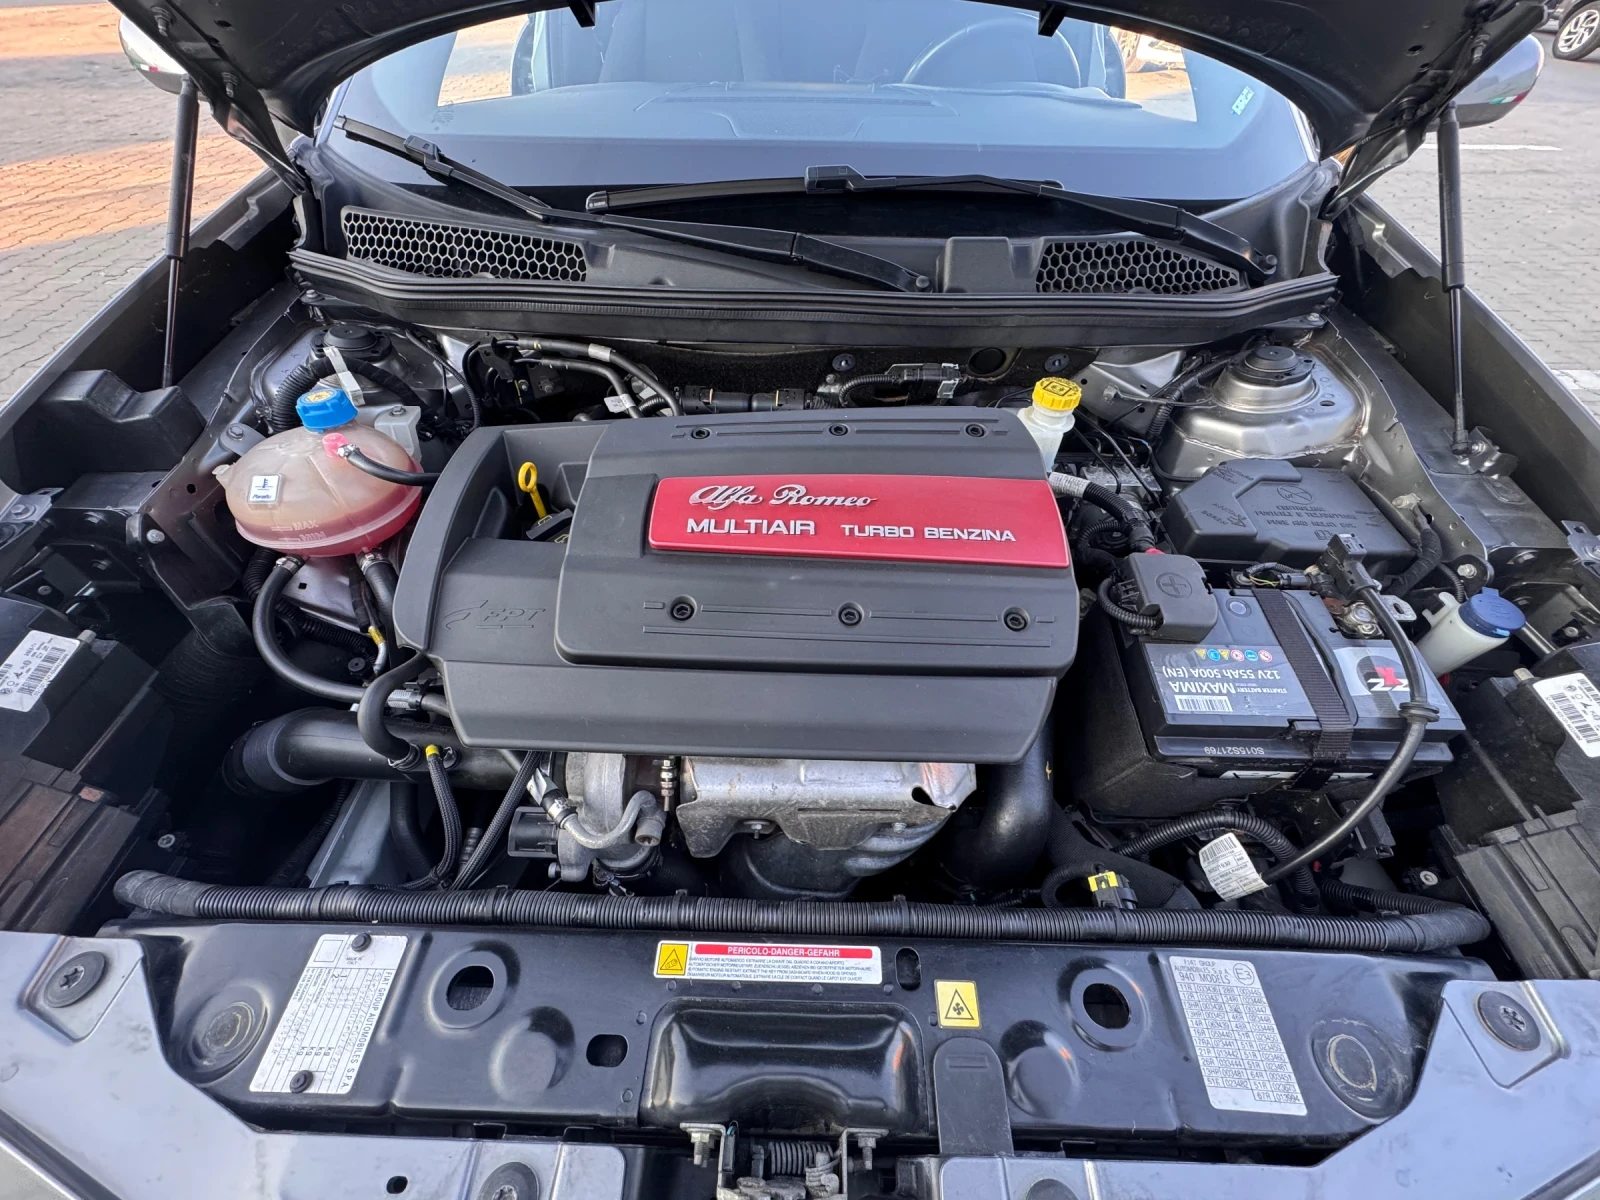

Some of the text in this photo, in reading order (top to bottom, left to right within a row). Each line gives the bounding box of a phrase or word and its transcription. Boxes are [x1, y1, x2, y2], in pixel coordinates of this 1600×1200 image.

[688, 484, 877, 512] Alfa Romeo
[292, 520, 318, 531] MAX
[686, 518, 1017, 543] MULTIAIR TURBO BENZINA
[1162, 666, 1281, 679] 12V 55Ah 500A (EN)
[1168, 681, 1235, 694] MAXIMA
[1204, 746, 1265, 755] S015S21769
[727, 946, 840, 956] PERICOLO-DANGER-GEFAHR
[382, 971, 392, 985] FIAT
[1178, 971, 1231, 984] 940 MODELS
[1234, 967, 1253, 980] E3
[372, 988, 386, 1011] GROUP
[350, 1013, 376, 1064] AUTOMOBILES
[297, 1046, 308, 1056] kg
[306, 1046, 316, 1056] kg
[315, 1047, 325, 1056] kg
[324, 1047, 334, 1056] kg
[340, 1068, 354, 1090] S.P.A.
